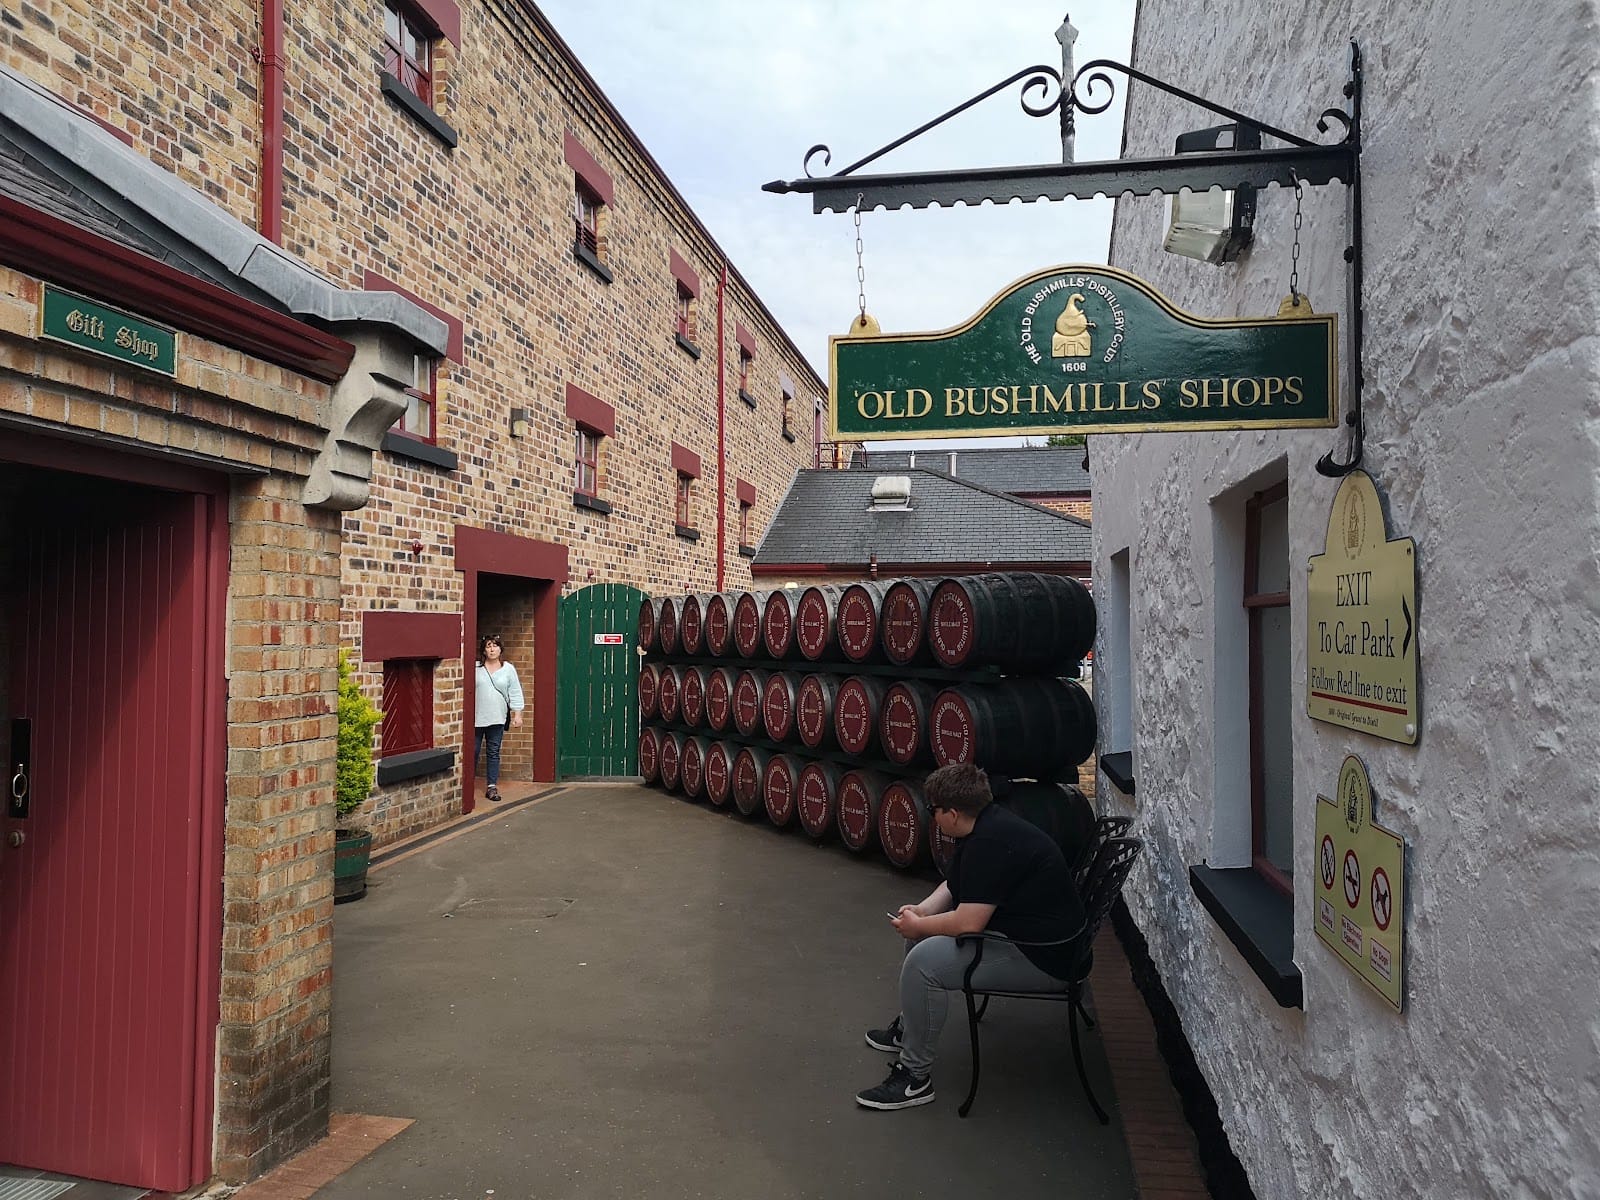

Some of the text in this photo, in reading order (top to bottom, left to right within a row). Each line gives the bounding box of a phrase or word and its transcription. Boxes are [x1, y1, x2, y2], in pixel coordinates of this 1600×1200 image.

[66, 309, 159, 361] Gift Shop
[1025, 343, 1041, 364] THE
[1088, 280, 1125, 331] DISTILLERY
[1062, 362, 1087, 372] 1608
[1179, 376, 1304, 408] SHOPS
[1336, 571, 1372, 607] EXIT
[1318, 618, 1396, 658] To Car Park
[1311, 667, 1408, 705] Follow Red line to exit
